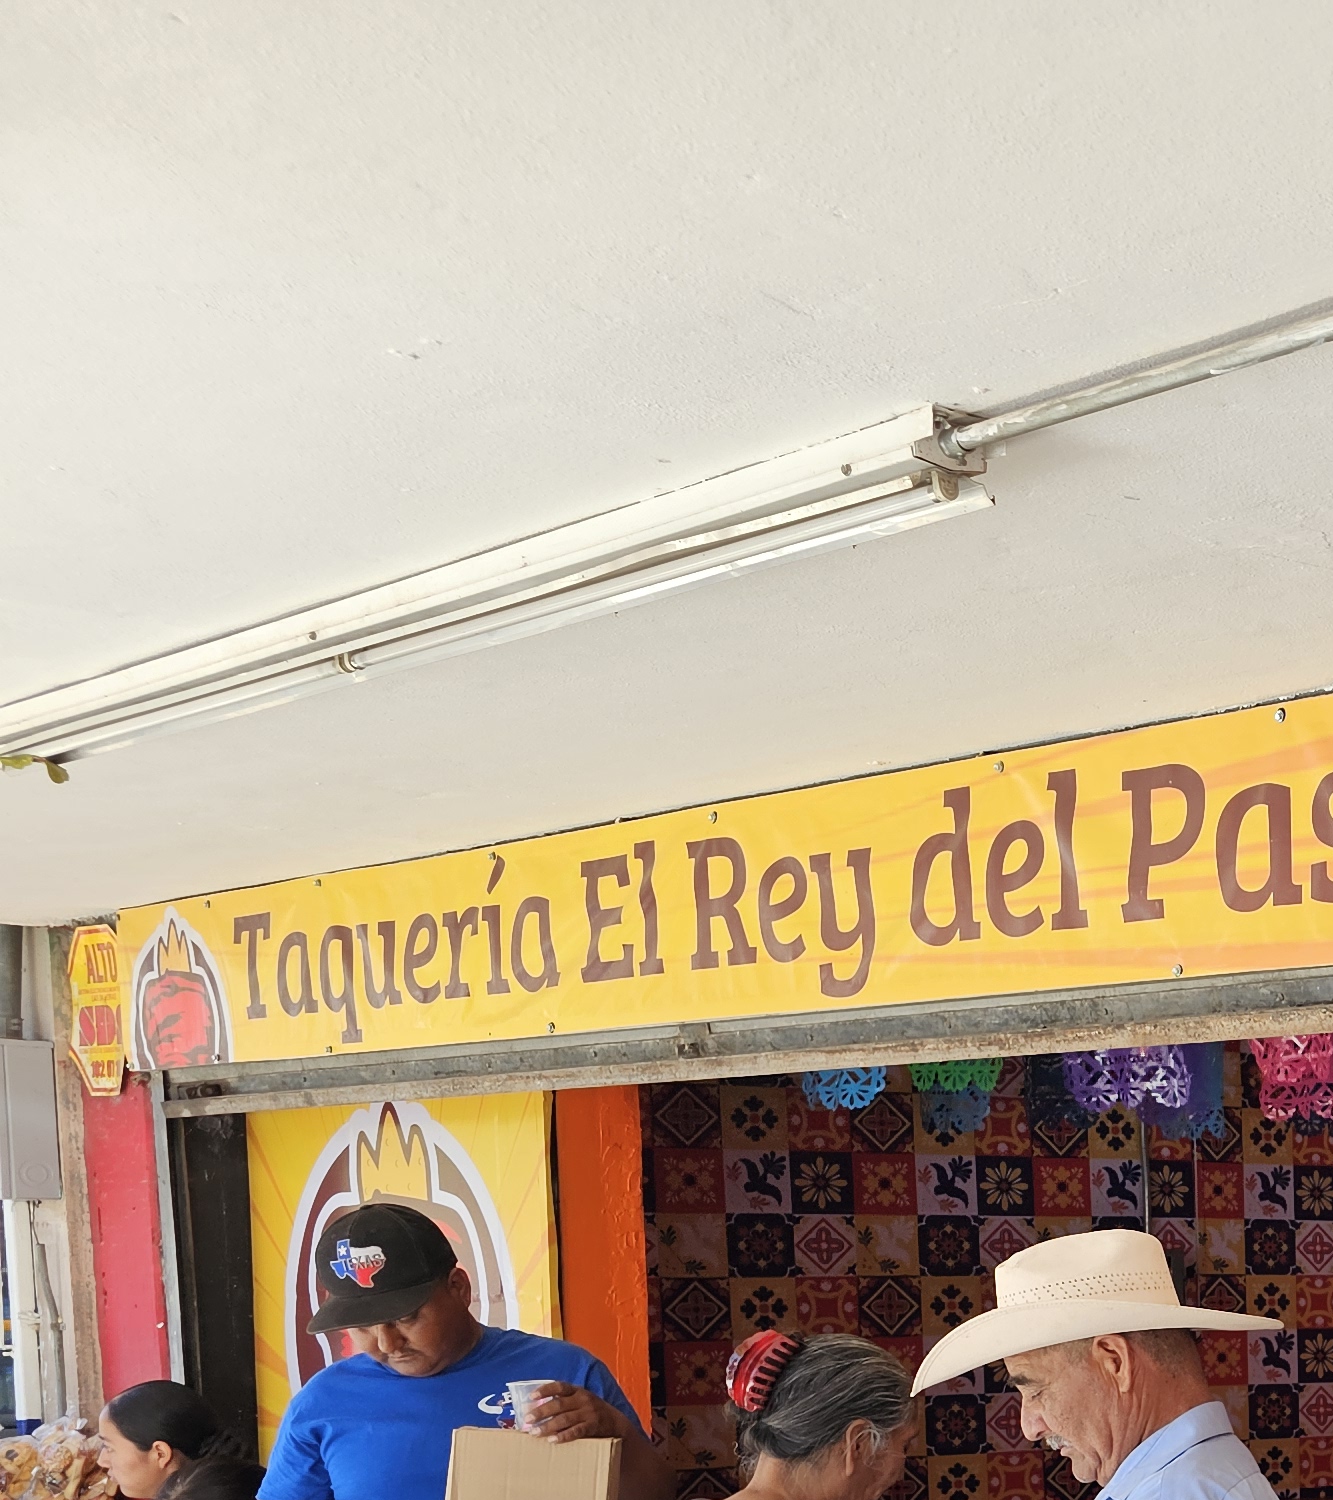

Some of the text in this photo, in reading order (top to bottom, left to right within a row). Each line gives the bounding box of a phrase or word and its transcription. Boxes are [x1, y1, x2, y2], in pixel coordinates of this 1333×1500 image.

[233, 856, 561, 1043] Taquería
[580, 840, 666, 984] El
[687, 836, 874, 998] Rey
[909, 769, 1089, 947] del
[84, 942, 118, 984] ALTO
[339, 1253, 384, 1272] TEXAS
